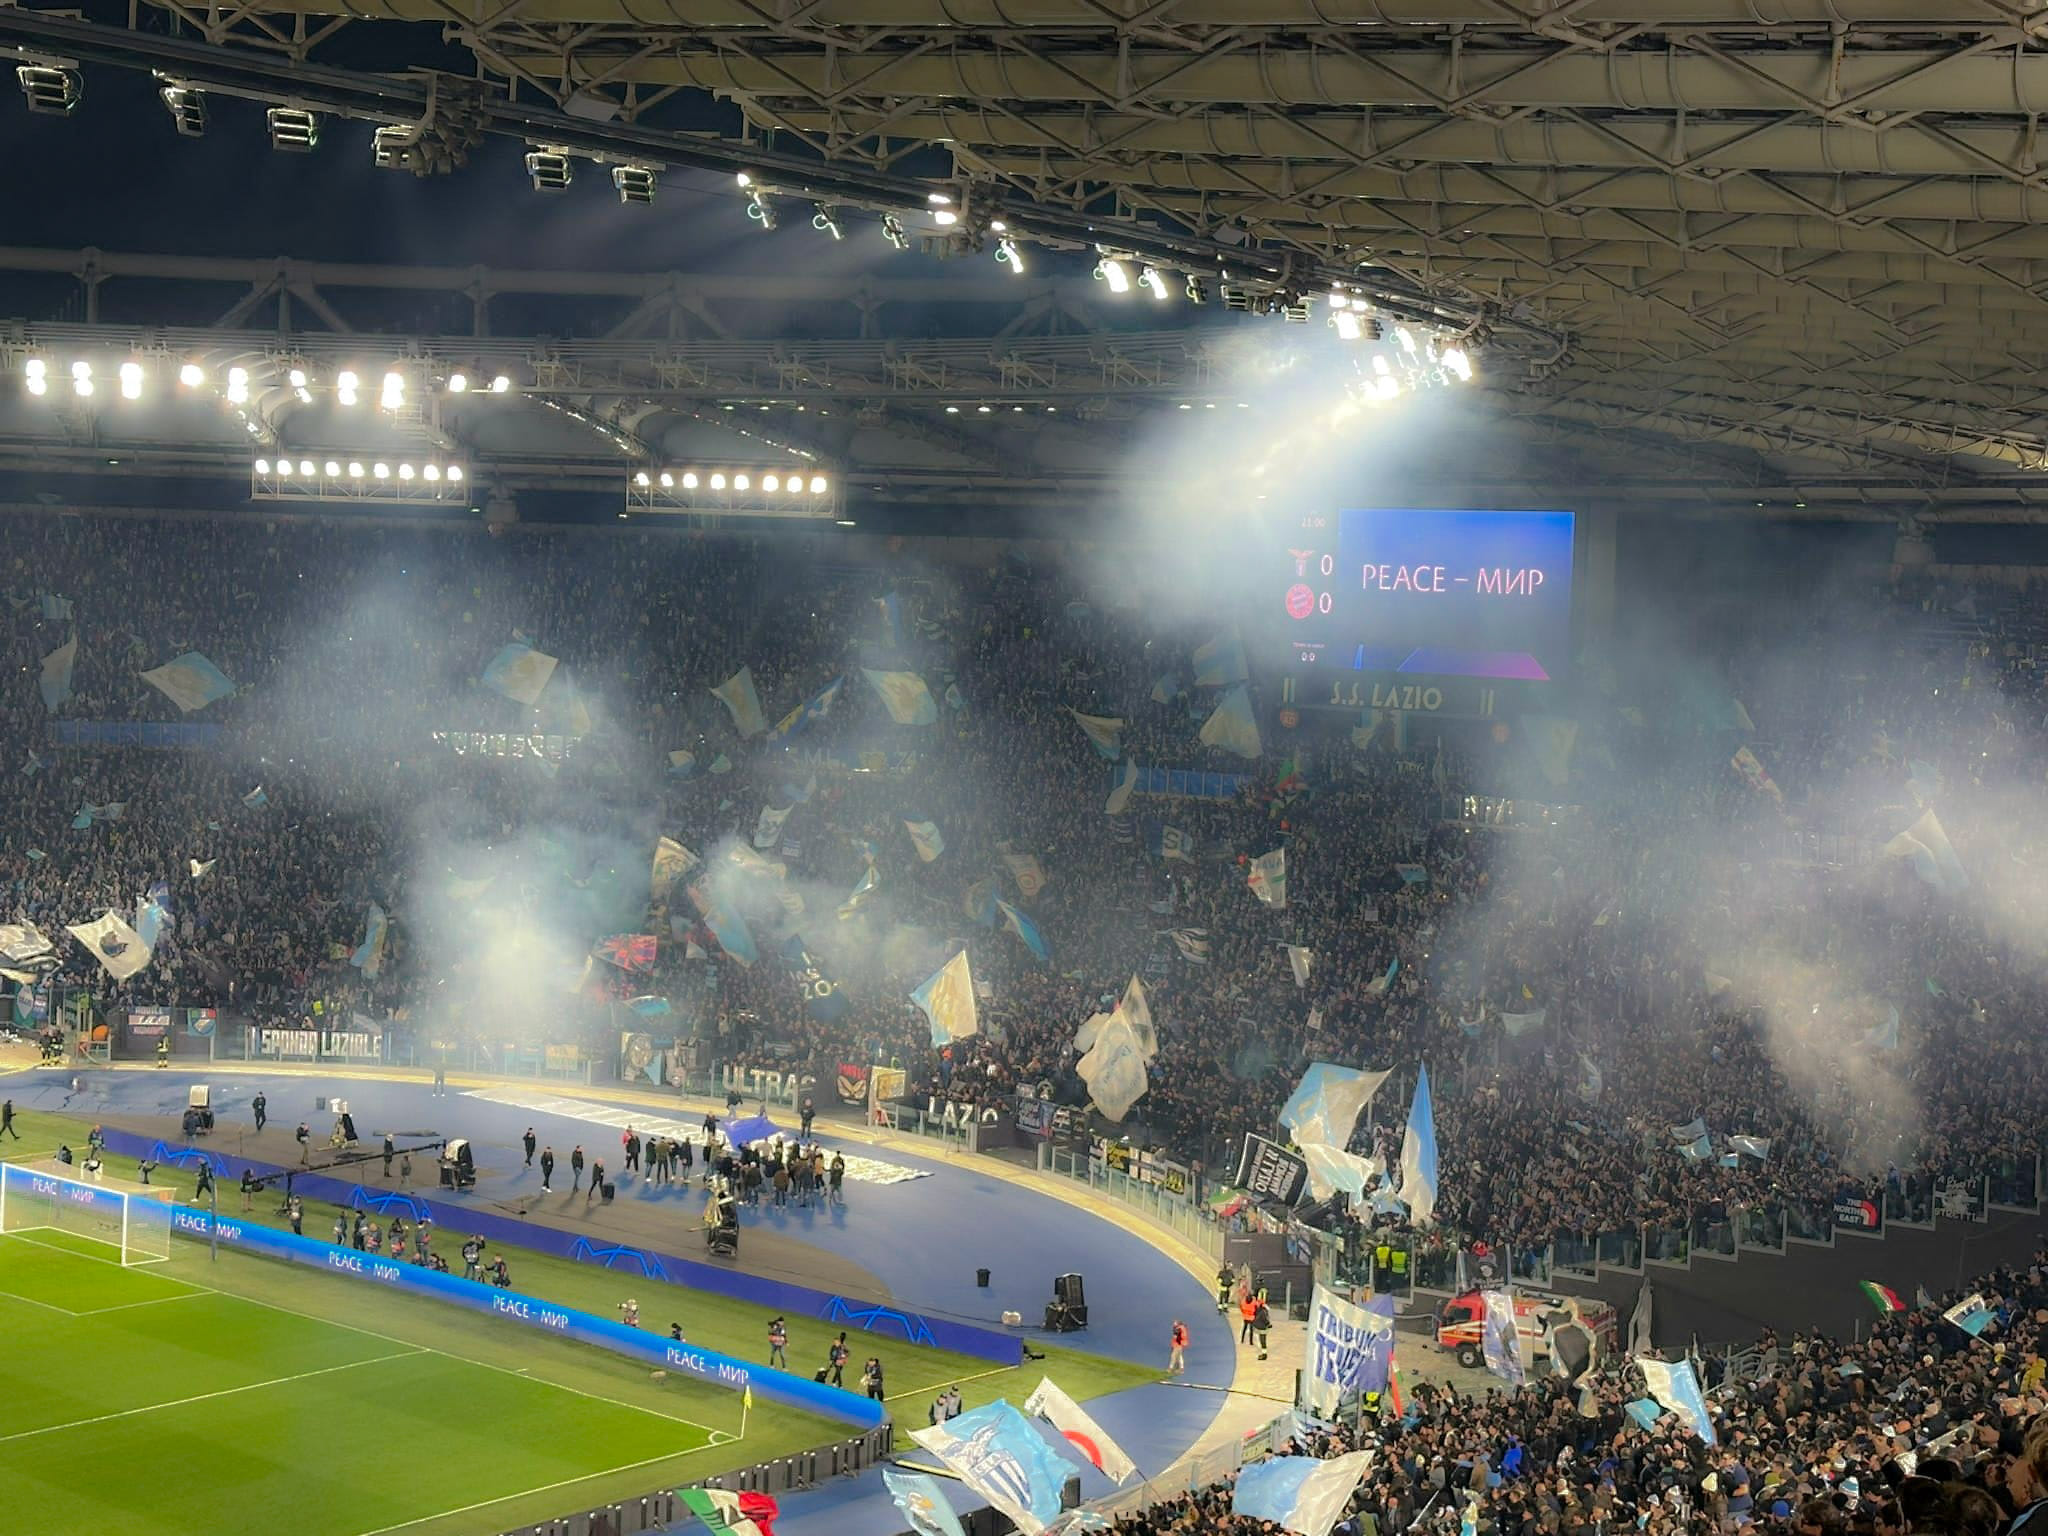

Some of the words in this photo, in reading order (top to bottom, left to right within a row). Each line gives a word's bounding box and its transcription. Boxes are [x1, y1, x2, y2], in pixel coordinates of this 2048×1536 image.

[1320, 554, 1333, 576] 0
[1362, 563, 1446, 592] PEACE
[1477, 567, 1544, 595] МИР
[1319, 592, 1332, 614] 0
[1330, 681, 1364, 706] S.S.
[1371, 683, 1442, 710] LAZIO
[32, 1177, 57, 1196] PEAC
[1833, 1204, 1861, 1216] NORTH
[175, 1212, 207, 1233] PEACE
[216, 1222, 242, 1241] МИР
[329, 1250, 363, 1273] PEACE
[373, 1262, 400, 1281] МИР
[492, 1295, 529, 1319] PEACE
[540, 1308, 568, 1329] МИР
[667, 1346, 705, 1372] PEACE
[718, 1361, 749, 1385] МИР
